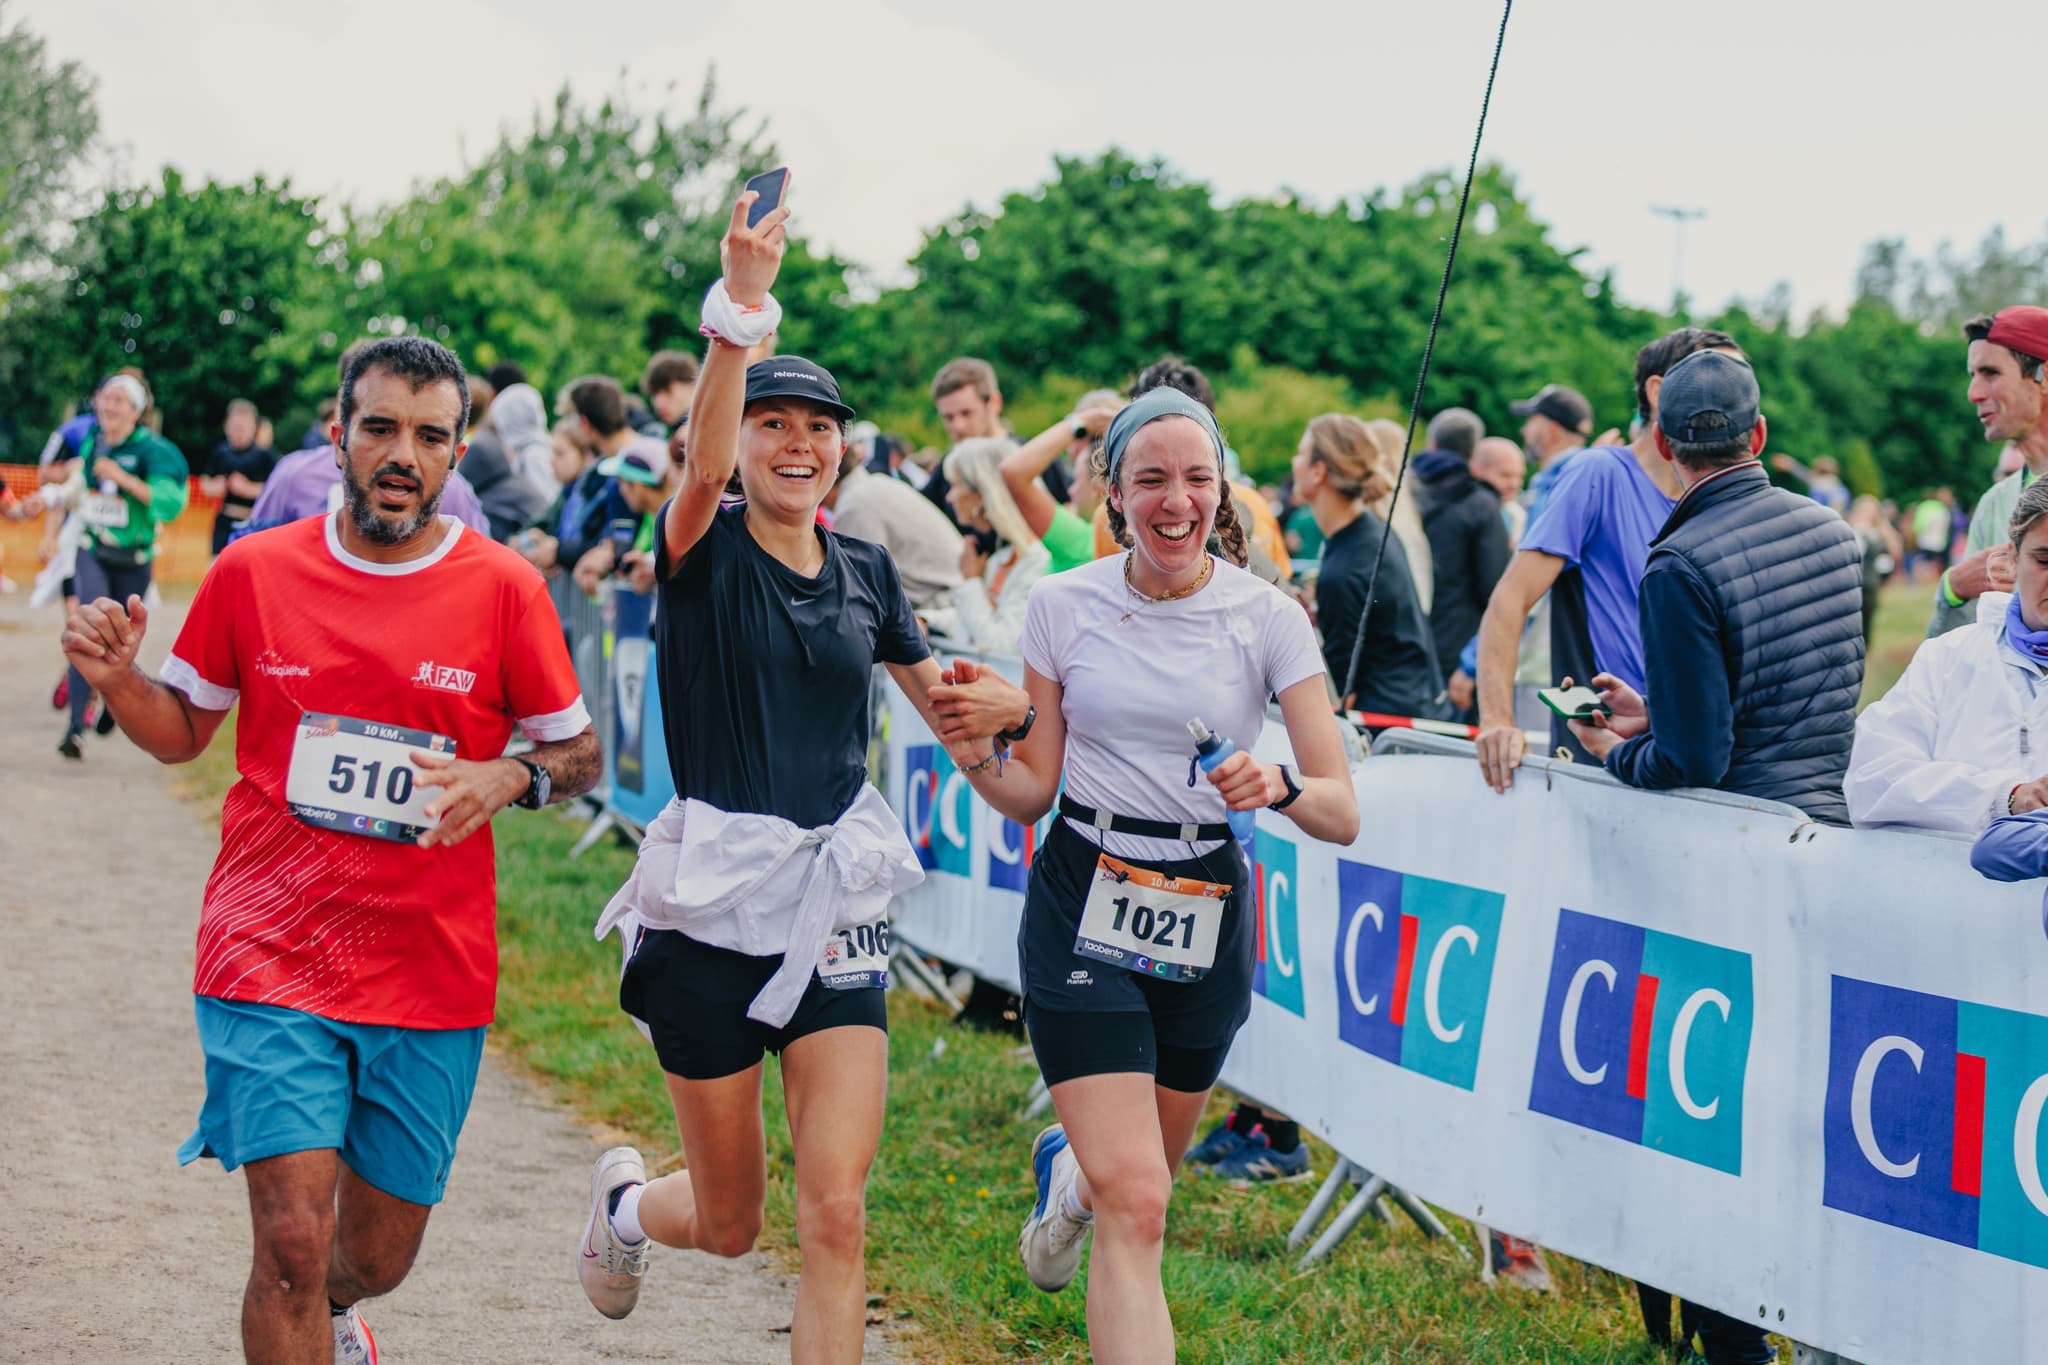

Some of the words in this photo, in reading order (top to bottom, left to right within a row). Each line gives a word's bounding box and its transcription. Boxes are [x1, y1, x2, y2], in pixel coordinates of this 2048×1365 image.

[438, 669, 475, 690] FAW
[364, 724, 378, 736] 10
[379, 727, 399, 740] KM
[328, 754, 413, 805] 510
[353, 815, 385, 833] CIC
[1151, 877, 1162, 887] 10
[1112, 896, 1196, 949] 1021
[1244, 852, 1294, 978] IC
[1138, 957, 1165, 974] CIC
[1343, 901, 1479, 1043] CIC
[1559, 959, 1731, 1120] CIC
